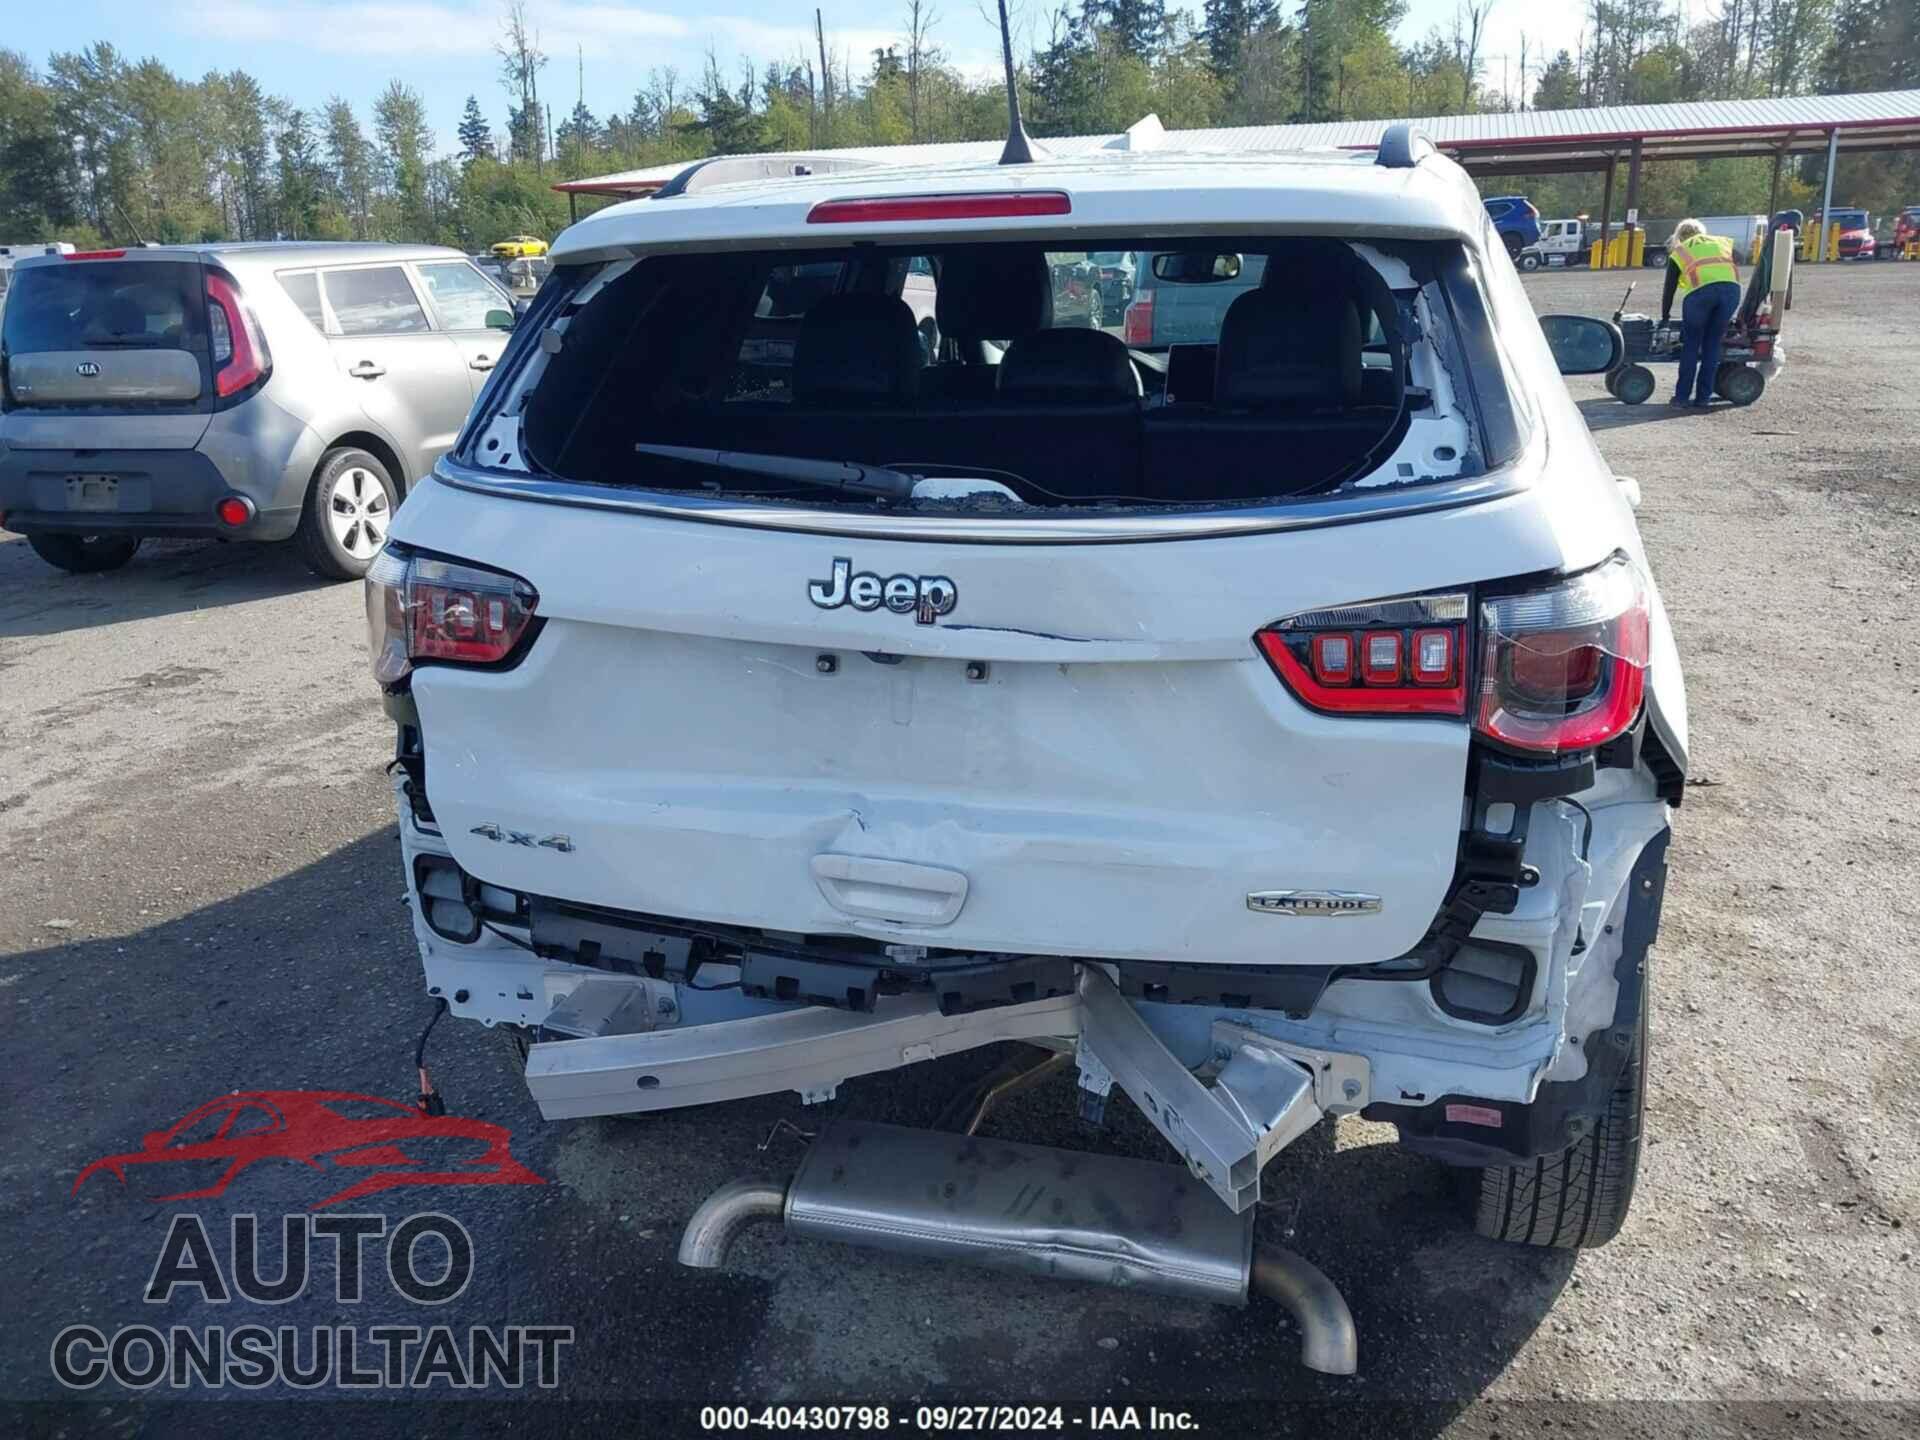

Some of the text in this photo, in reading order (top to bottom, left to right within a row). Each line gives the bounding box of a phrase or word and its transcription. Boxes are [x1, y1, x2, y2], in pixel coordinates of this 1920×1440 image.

[78, 364, 98, 374] KIA
[808, 557, 957, 625] Jeep
[1254, 896, 1368, 909] LATITUDE
